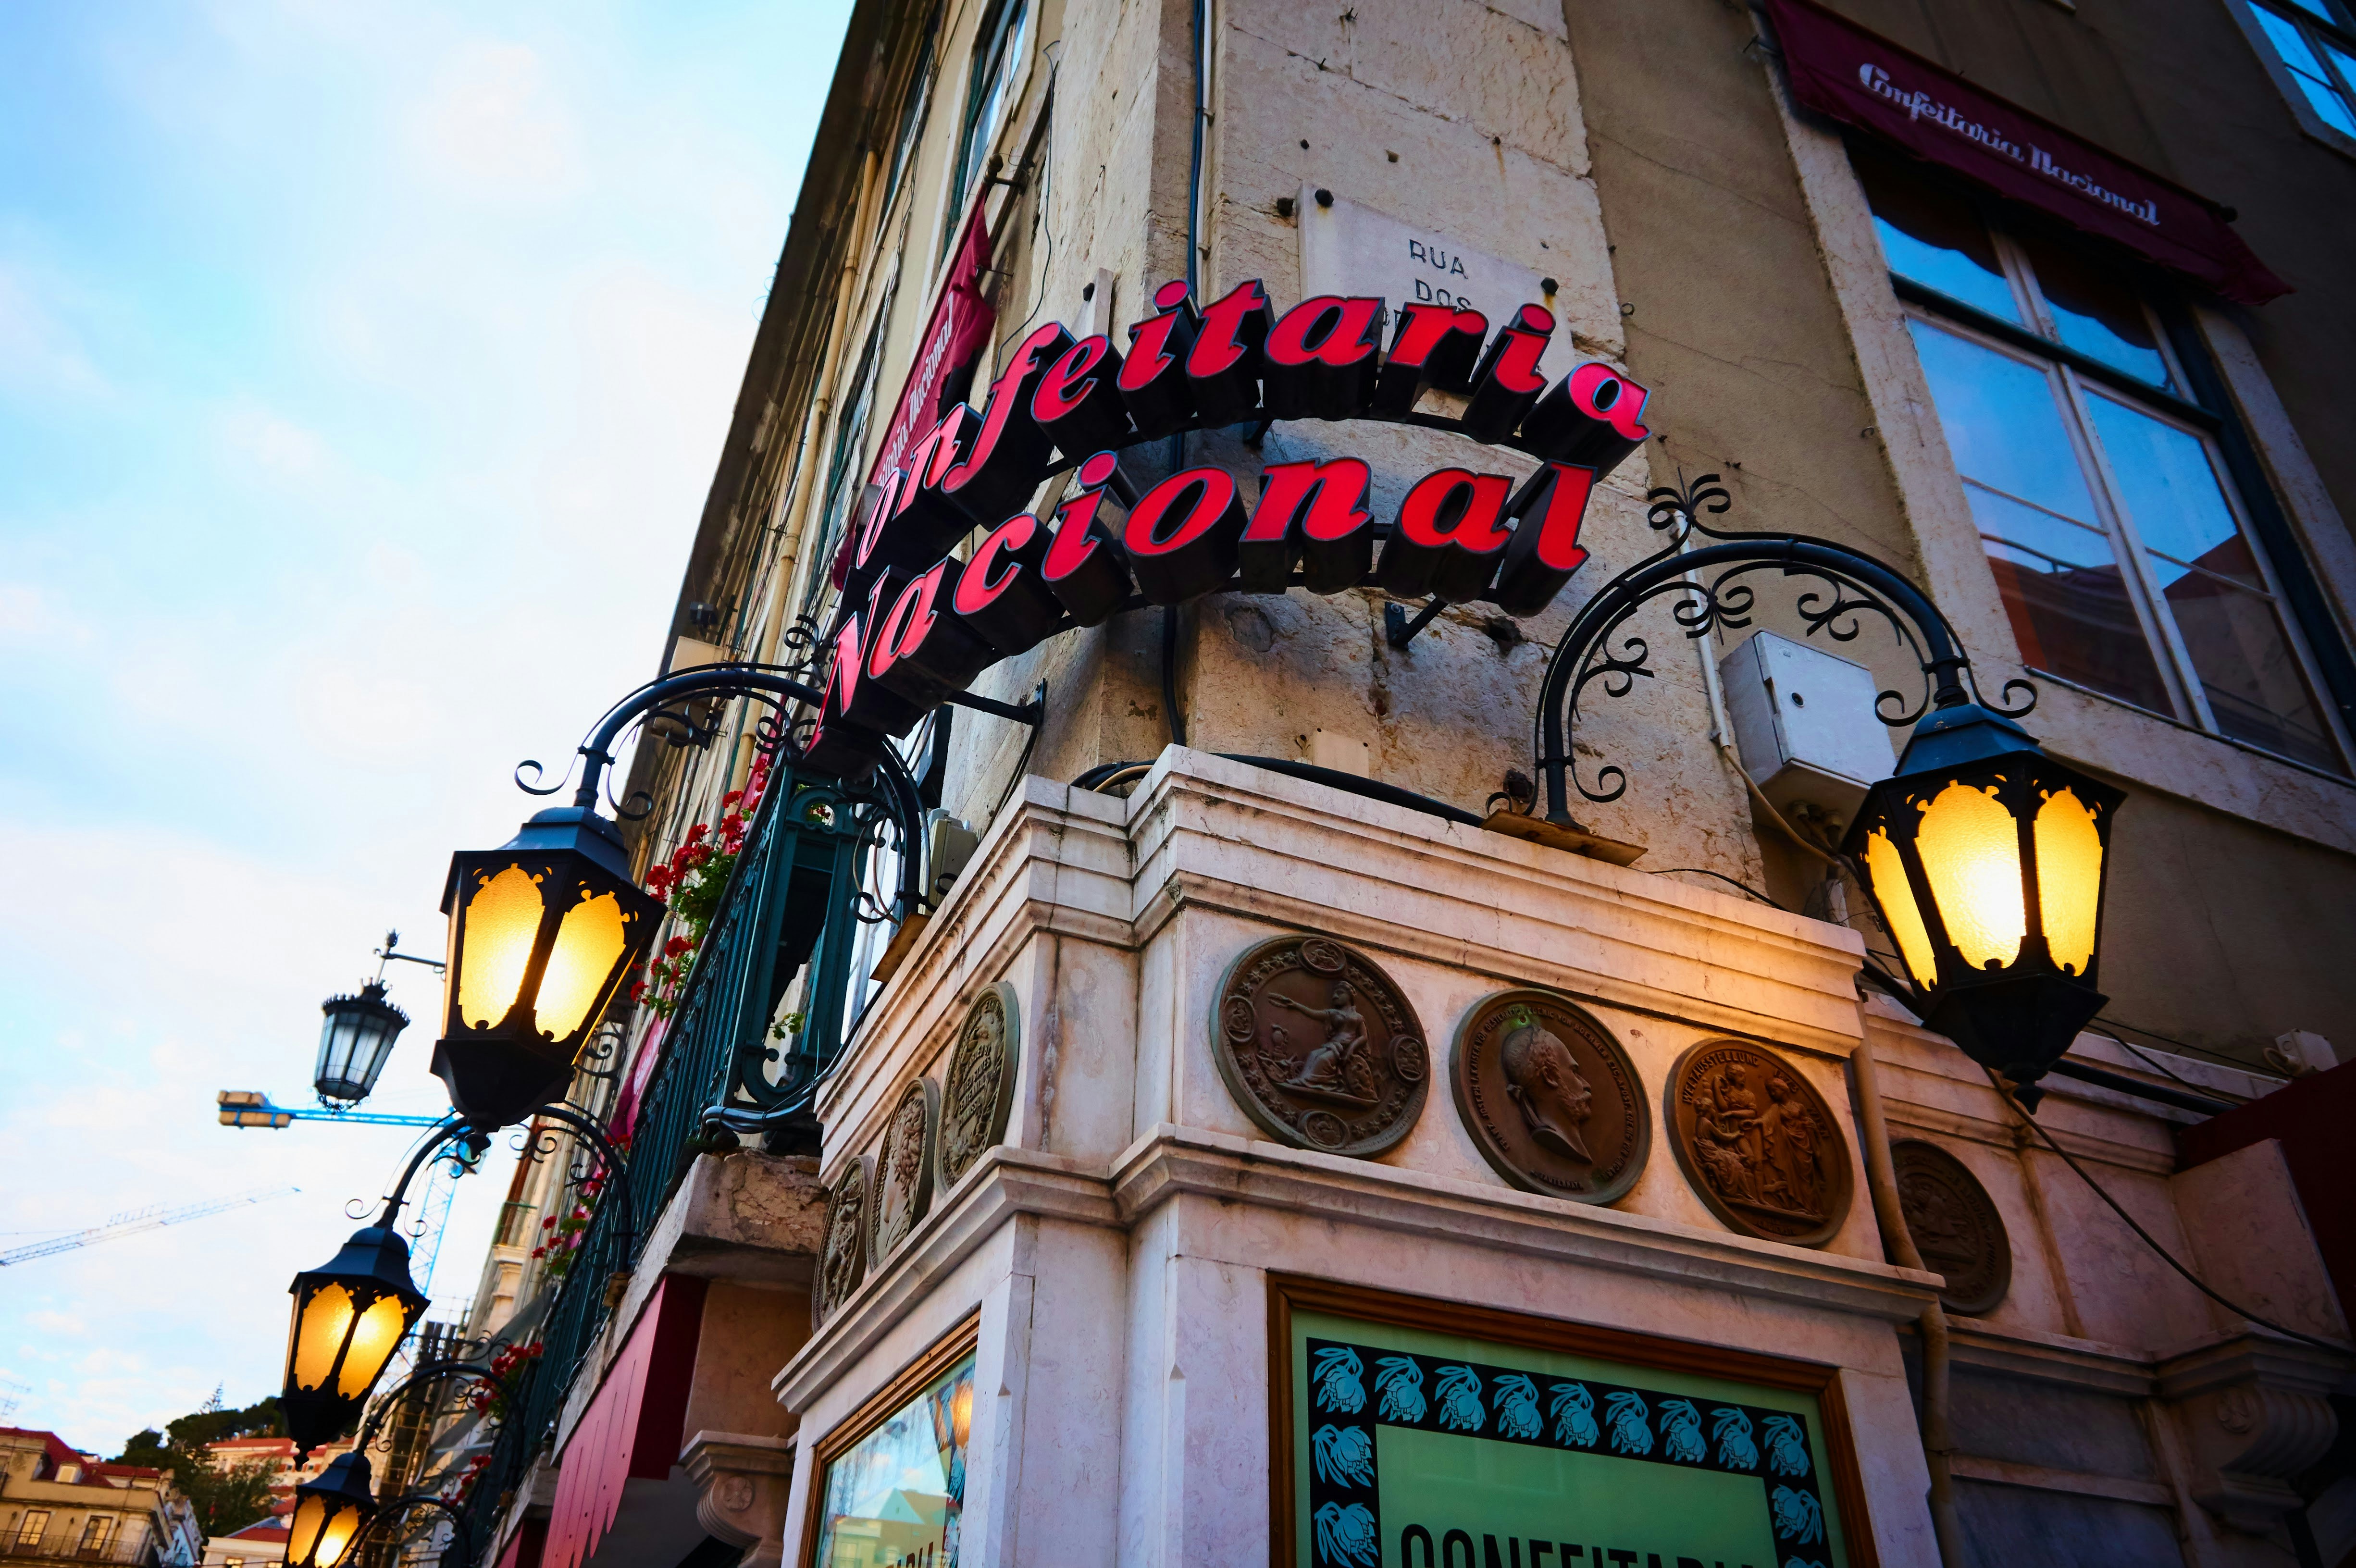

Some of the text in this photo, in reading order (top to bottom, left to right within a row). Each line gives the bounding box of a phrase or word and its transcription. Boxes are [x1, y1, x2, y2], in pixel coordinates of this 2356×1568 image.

[1859, 62, 2160, 226] Confeitaria Nacional
[1409, 239, 1468, 279] RUA
[856, 278, 1652, 570] onfeitaria
[909, 291, 954, 432] Nacional
[802, 450, 1598, 759] Nacional
[1682, 1050, 1760, 1105] WELTAUSSTELLUNG
[1773, 1068, 1800, 1094] 1873
